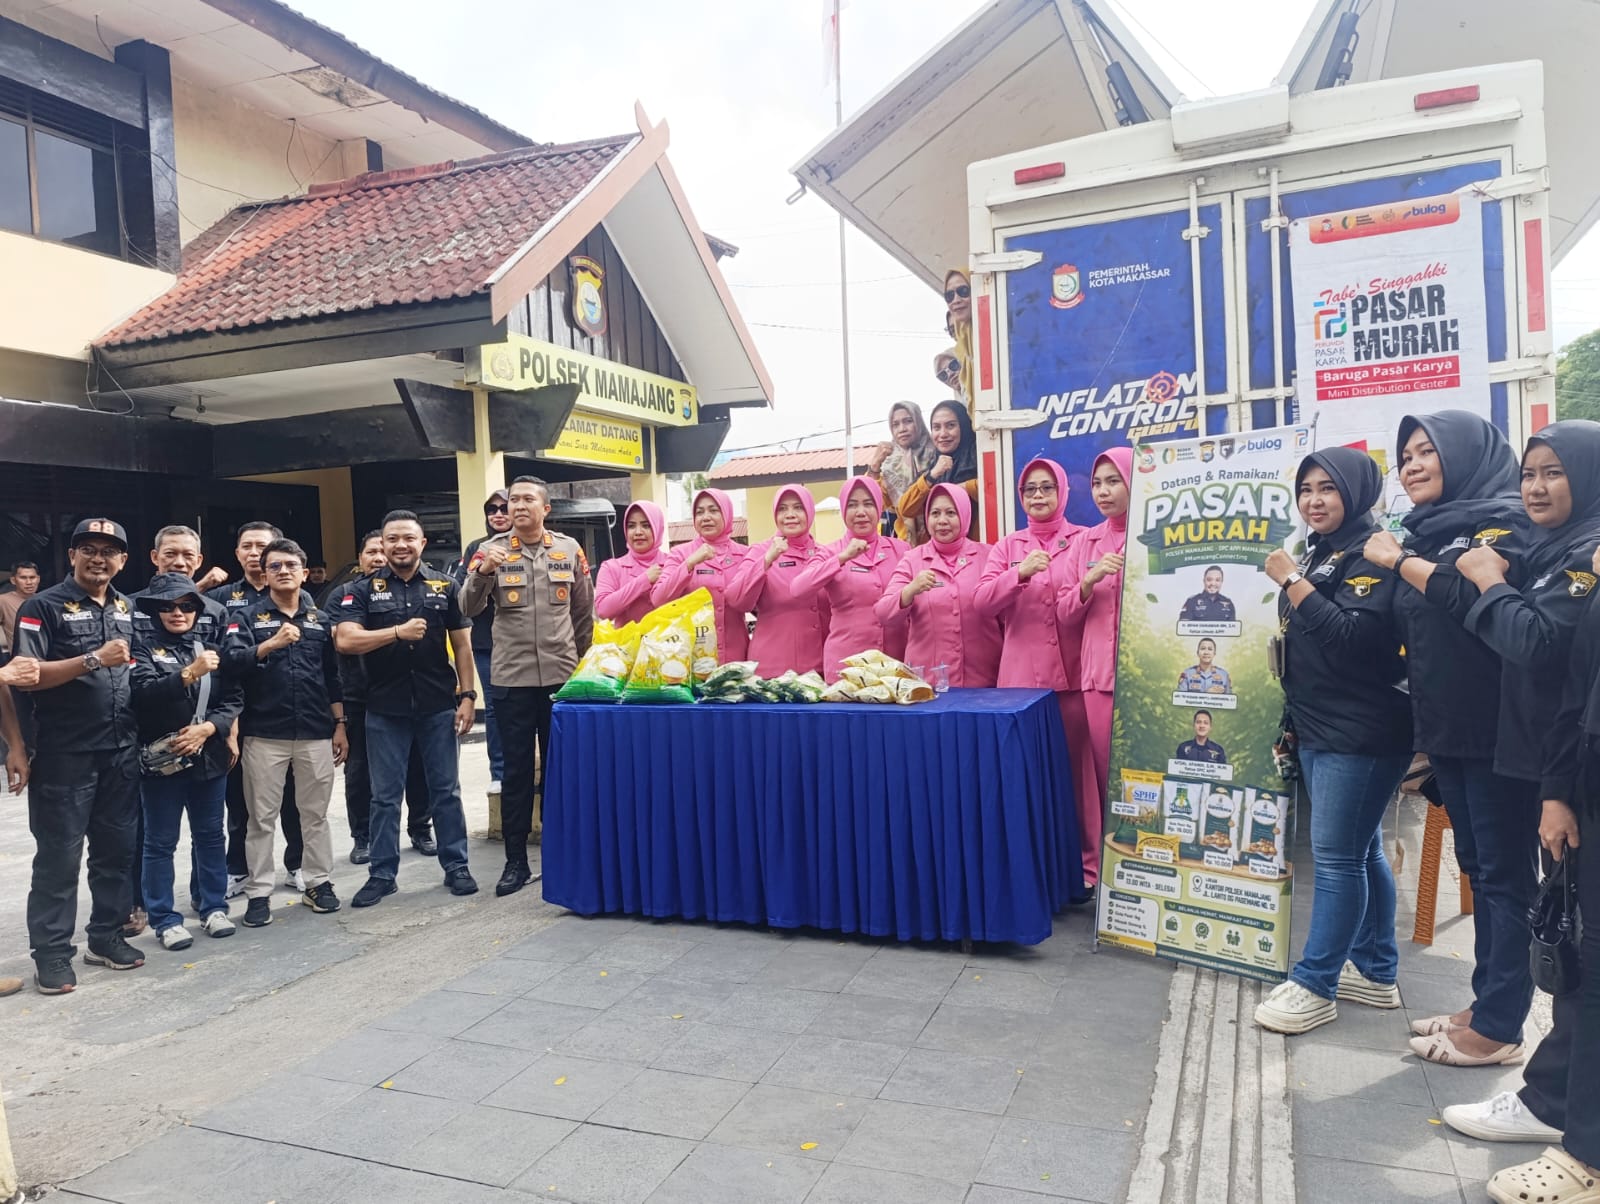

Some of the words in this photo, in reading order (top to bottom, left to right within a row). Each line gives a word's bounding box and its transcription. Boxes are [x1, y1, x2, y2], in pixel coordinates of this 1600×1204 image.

[1412, 203, 1446, 216] bulog
[1088, 263, 1149, 279] PEMERINTAH
[1089, 278, 1115, 288] KOTA
[1117, 269, 1170, 284] MAKASSAR
[1368, 262, 1447, 294] Singgahki
[1351, 284, 1446, 326] PASAR
[1352, 319, 1459, 362] MURAH
[1315, 356, 1347, 367] KARYA
[1323, 368, 1369, 382] Baruga
[1373, 363, 1409, 376] Pasar
[1413, 360, 1453, 375] Karya
[520, 347, 590, 394] POLSEK
[595, 368, 675, 415] MAMAJANG
[1328, 388, 1349, 399] Mini
[1352, 383, 1410, 396] Distribution
[1413, 379, 1448, 390] Center
[1050, 397, 1198, 439] CONTROL
[601, 424, 639, 442] DATANG
[1248, 438, 1282, 451] bulog
[1161, 474, 1200, 491] Datang
[1205, 471, 1214, 481] &
[1219, 468, 1279, 480] Ramaikan!
[1146, 483, 1289, 531] PASAR
[1164, 519, 1269, 546] MURAH
[1133, 790, 1157, 800] SPHP
[1225, 886, 1243, 895] POLSEK
